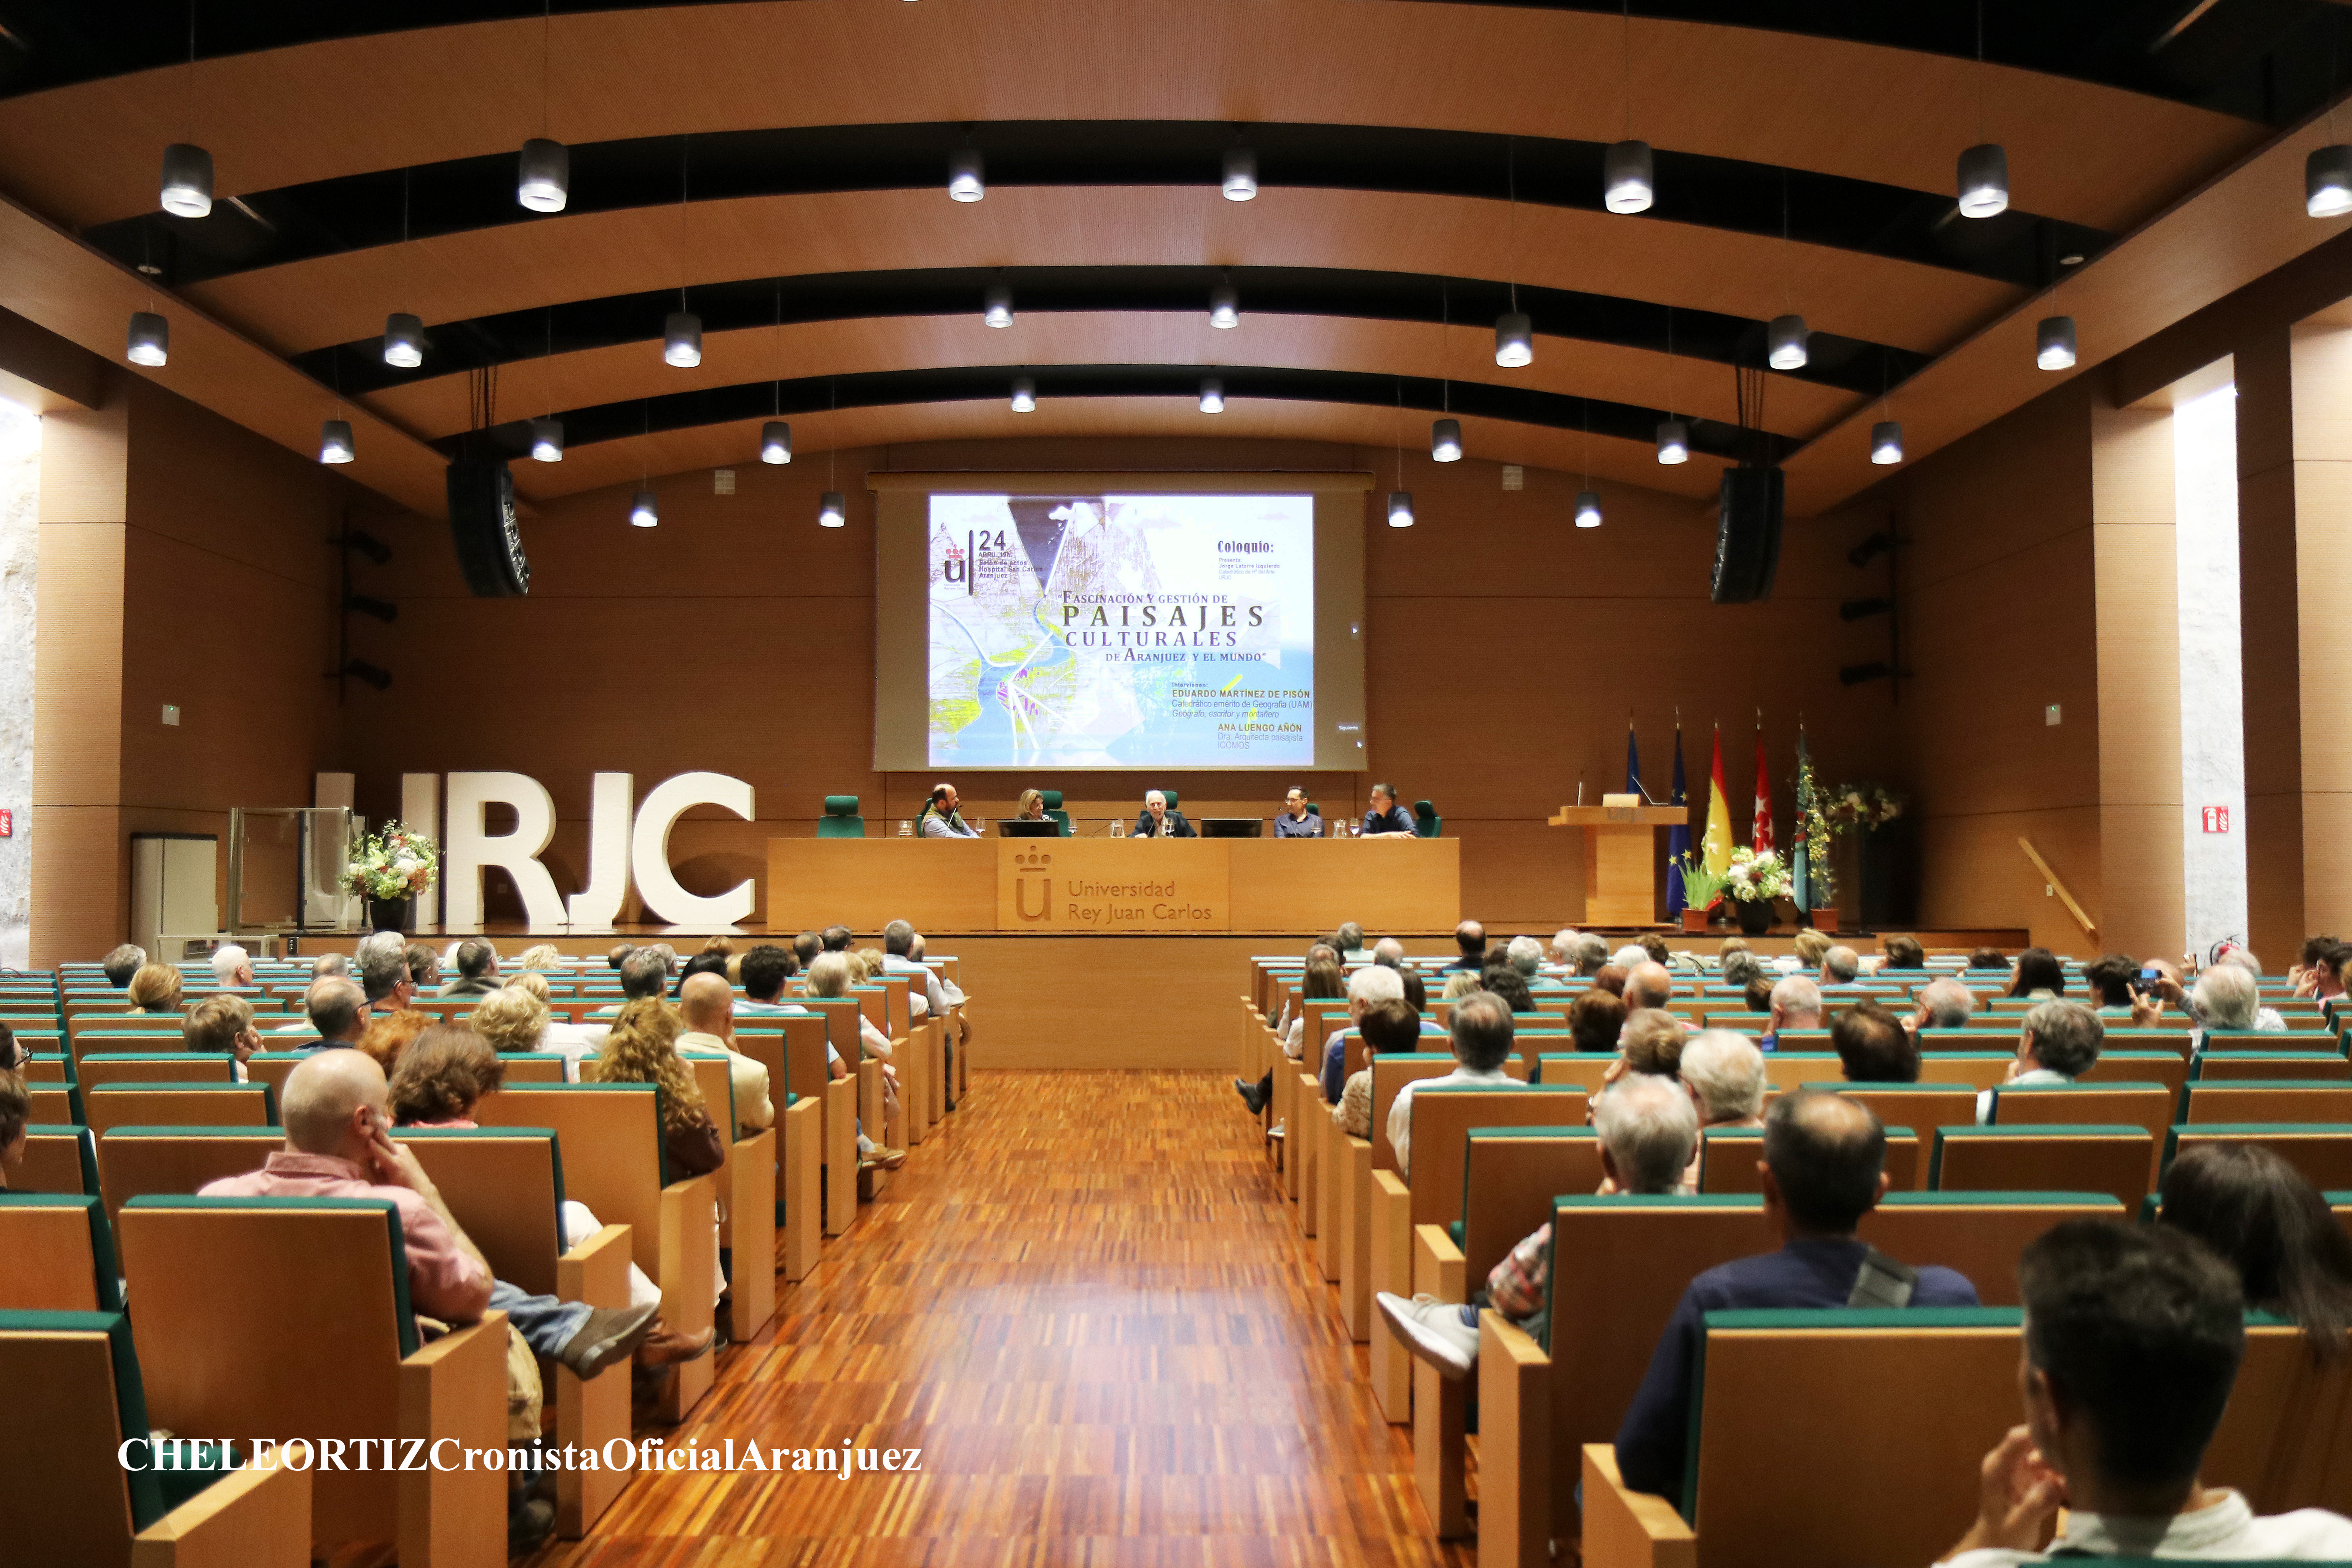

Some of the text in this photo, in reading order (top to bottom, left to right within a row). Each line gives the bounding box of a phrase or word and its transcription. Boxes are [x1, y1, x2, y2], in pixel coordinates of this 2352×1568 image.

[979, 530, 1006, 551] 24
[1158, 593, 1208, 603] GESTIÓN
[1063, 606, 1262, 632] PAISAJES
[1066, 632, 1236, 646] CULTURALES
[1124, 648, 1186, 663] ARANJUEZ
[1220, 689, 1265, 698] MARTÍNEZ
[1283, 689, 1310, 698] PISÓN
[1253, 700, 1286, 710] Geografía
[1289, 700, 1312, 709] (UAM)
[1173, 710, 1206, 718] Geógrafo,
[1277, 723, 1302, 732] AÑÓN
[1235, 733, 1268, 742] Arquitecta
[1271, 734, 1303, 743] paisajista
[1218, 741, 1249, 750] ICOMOS
[1069, 880, 1175, 897] Universidad
[1069, 903, 1211, 925] Rey Juan Carlos
